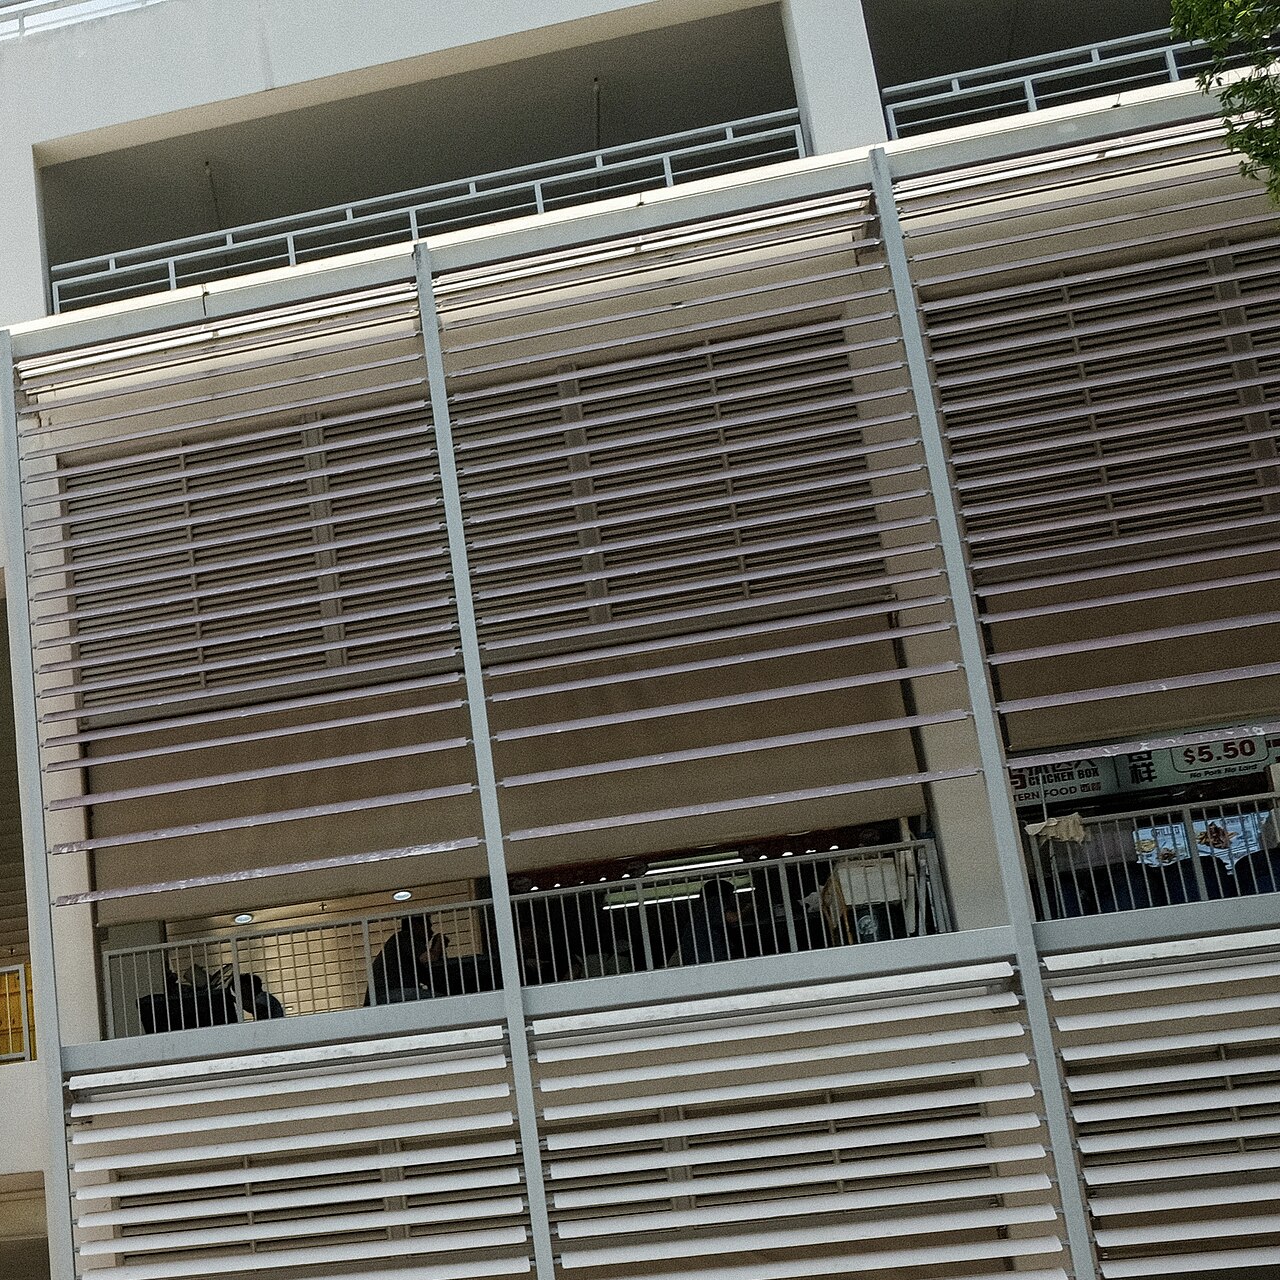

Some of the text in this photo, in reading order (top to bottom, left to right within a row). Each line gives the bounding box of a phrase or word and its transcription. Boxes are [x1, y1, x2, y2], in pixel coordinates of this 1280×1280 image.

[1183, 739, 1256, 765] $5.50
[1028, 770, 1076, 787] CHICKEN
[1190, 771, 1202, 779] No
[1204, 768, 1222, 777] Pork
[1238, 763, 1258, 772] Lard
[1013, 790, 1040, 802] TERN
[1043, 784, 1077, 799] FOOD
